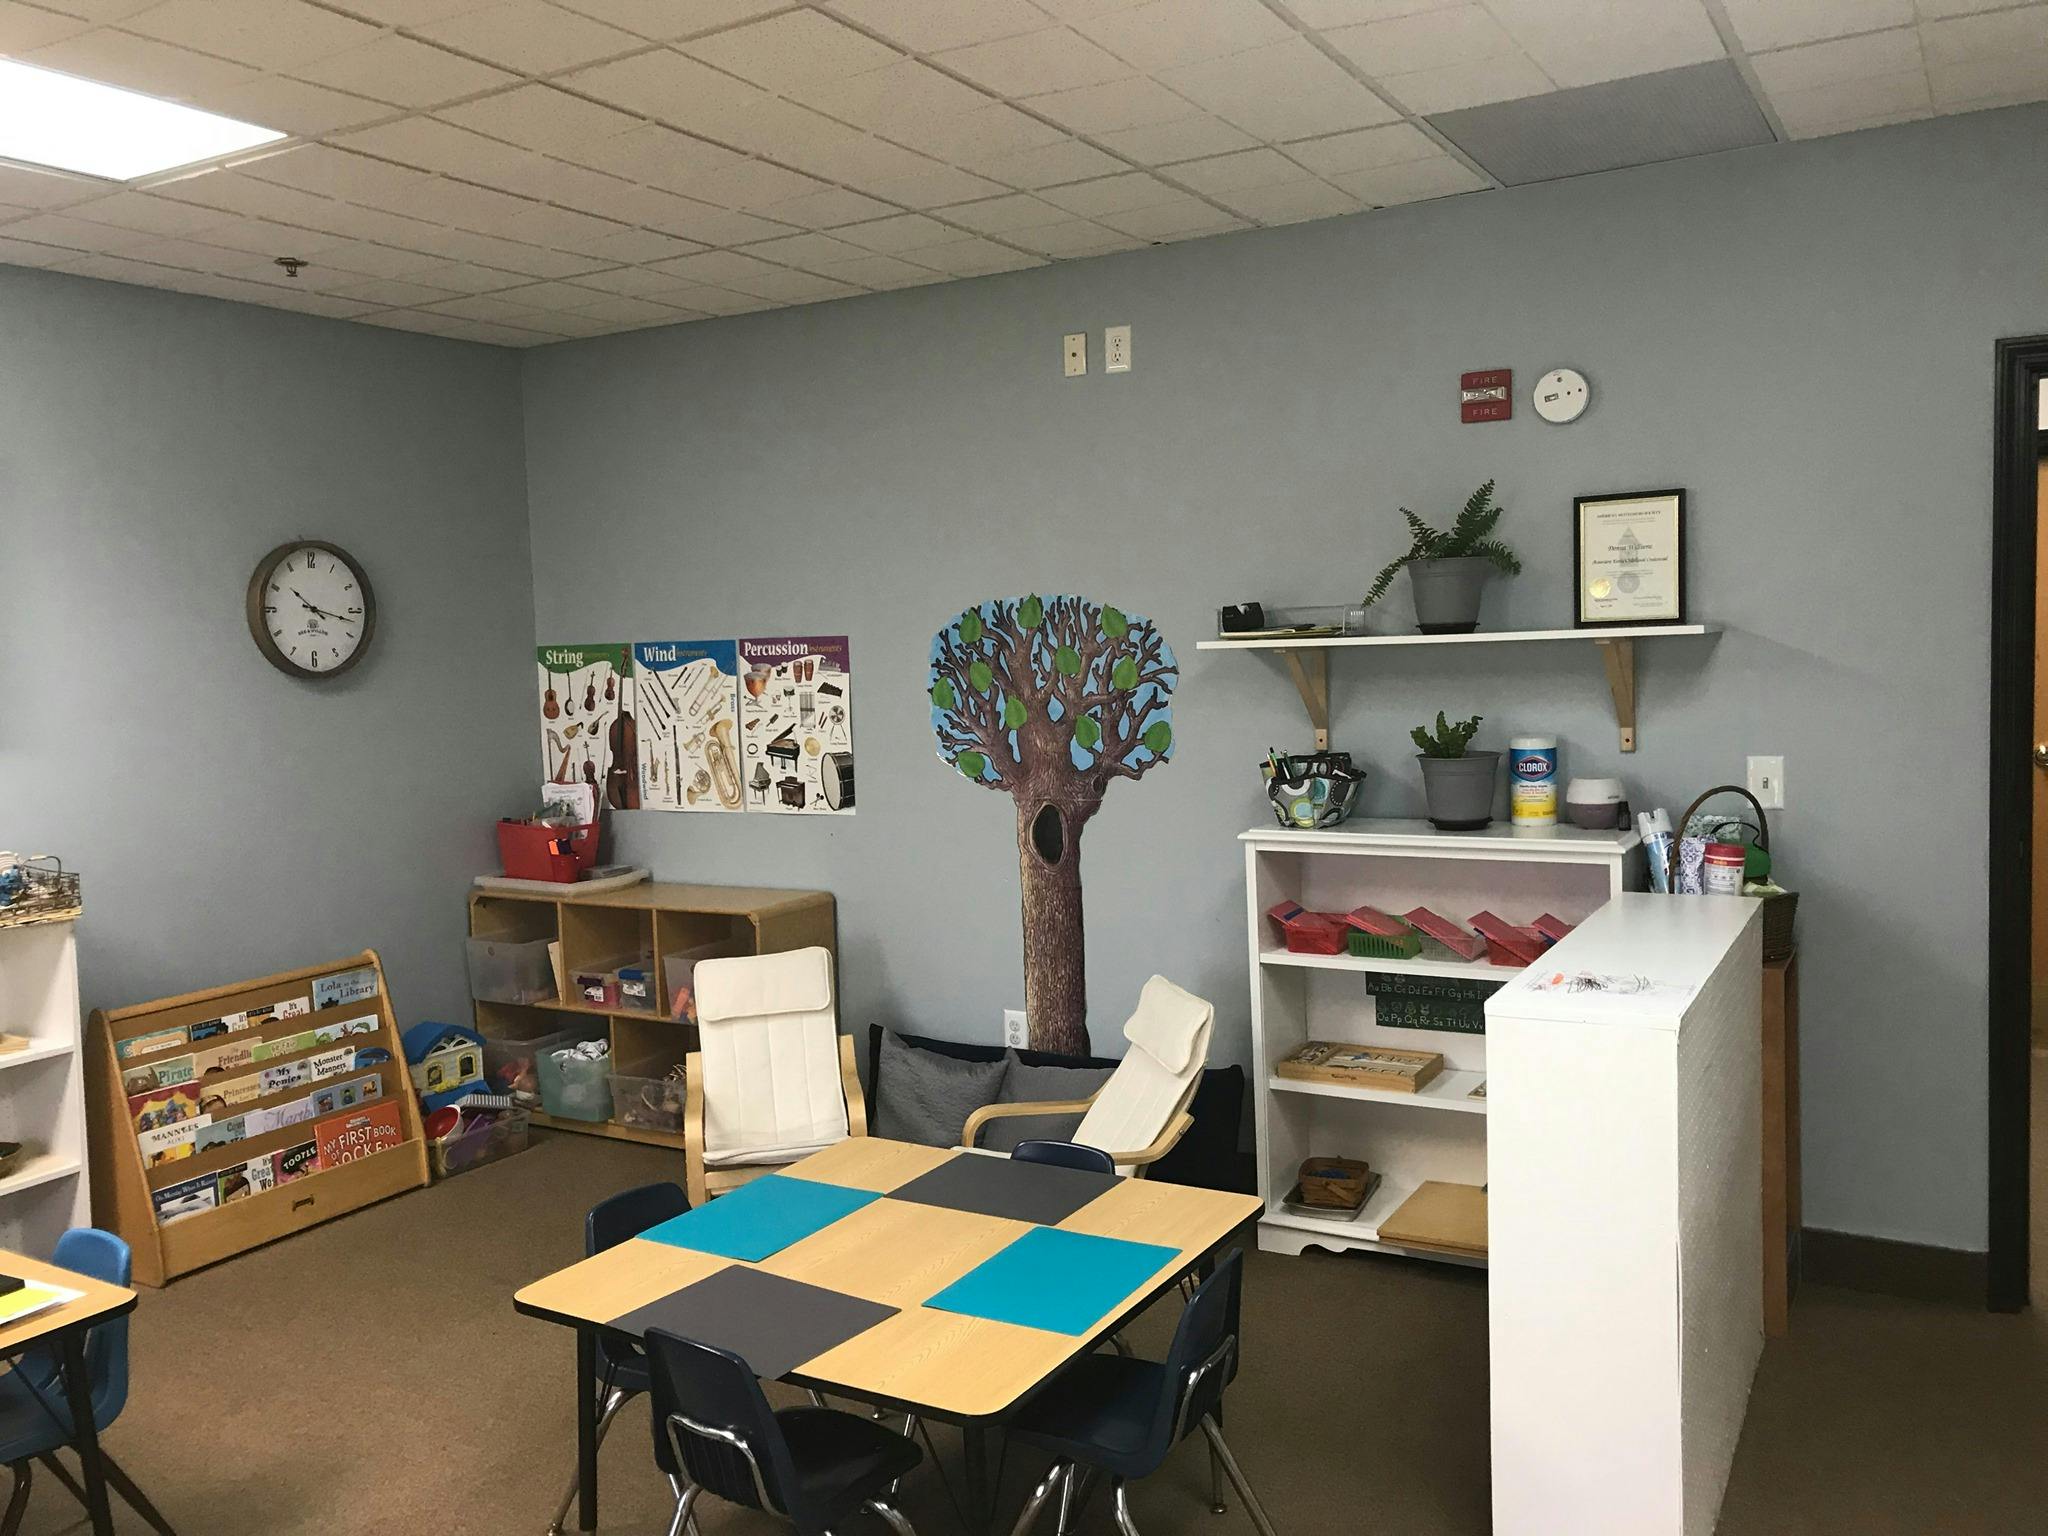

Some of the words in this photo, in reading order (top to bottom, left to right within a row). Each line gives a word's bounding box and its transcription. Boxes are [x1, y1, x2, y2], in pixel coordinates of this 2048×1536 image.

[1472, 376, 1498, 385] FIRE
[1472, 408, 1498, 416] FIRE
[307, 551, 316, 569] 12
[643, 645, 677, 662] Wind
[744, 640, 809, 657] Percussion
[311, 650, 318, 668] 6
[545, 649, 584, 668] String
[1518, 762, 1548, 772] CLOROX
[640, 762, 649, 800] Woodwind
[320, 980, 342, 993] Lola
[340, 983, 376, 999] Library
[1377, 1012, 1389, 1021] Oo
[1391, 1014, 1402, 1025] Pp
[1405, 1015, 1419, 1027] Qq
[1420, 1016, 1430, 1025] Rr
[1433, 1017, 1443, 1026] Ss
[1446, 1018, 1456, 1027] Tt
[1459, 1018, 1470, 1029] Uu
[1472, 1022, 1484, 1030] Vv
[313, 1053, 343, 1069] Monster
[316, 1062, 347, 1076] Manners
[268, 1072, 302, 1089] Ponies
[275, 1066, 291, 1078] My
[151, 1123, 199, 1142] MANNERS
[323, 1139, 337, 1156] MY
[338, 1126, 372, 1150] FIRST
[373, 1125, 397, 1138] BOOK
[283, 1146, 317, 1171] TOOTLE
[335, 1141, 395, 1165] OCKE
[259, 1179, 273, 1191] Wo
